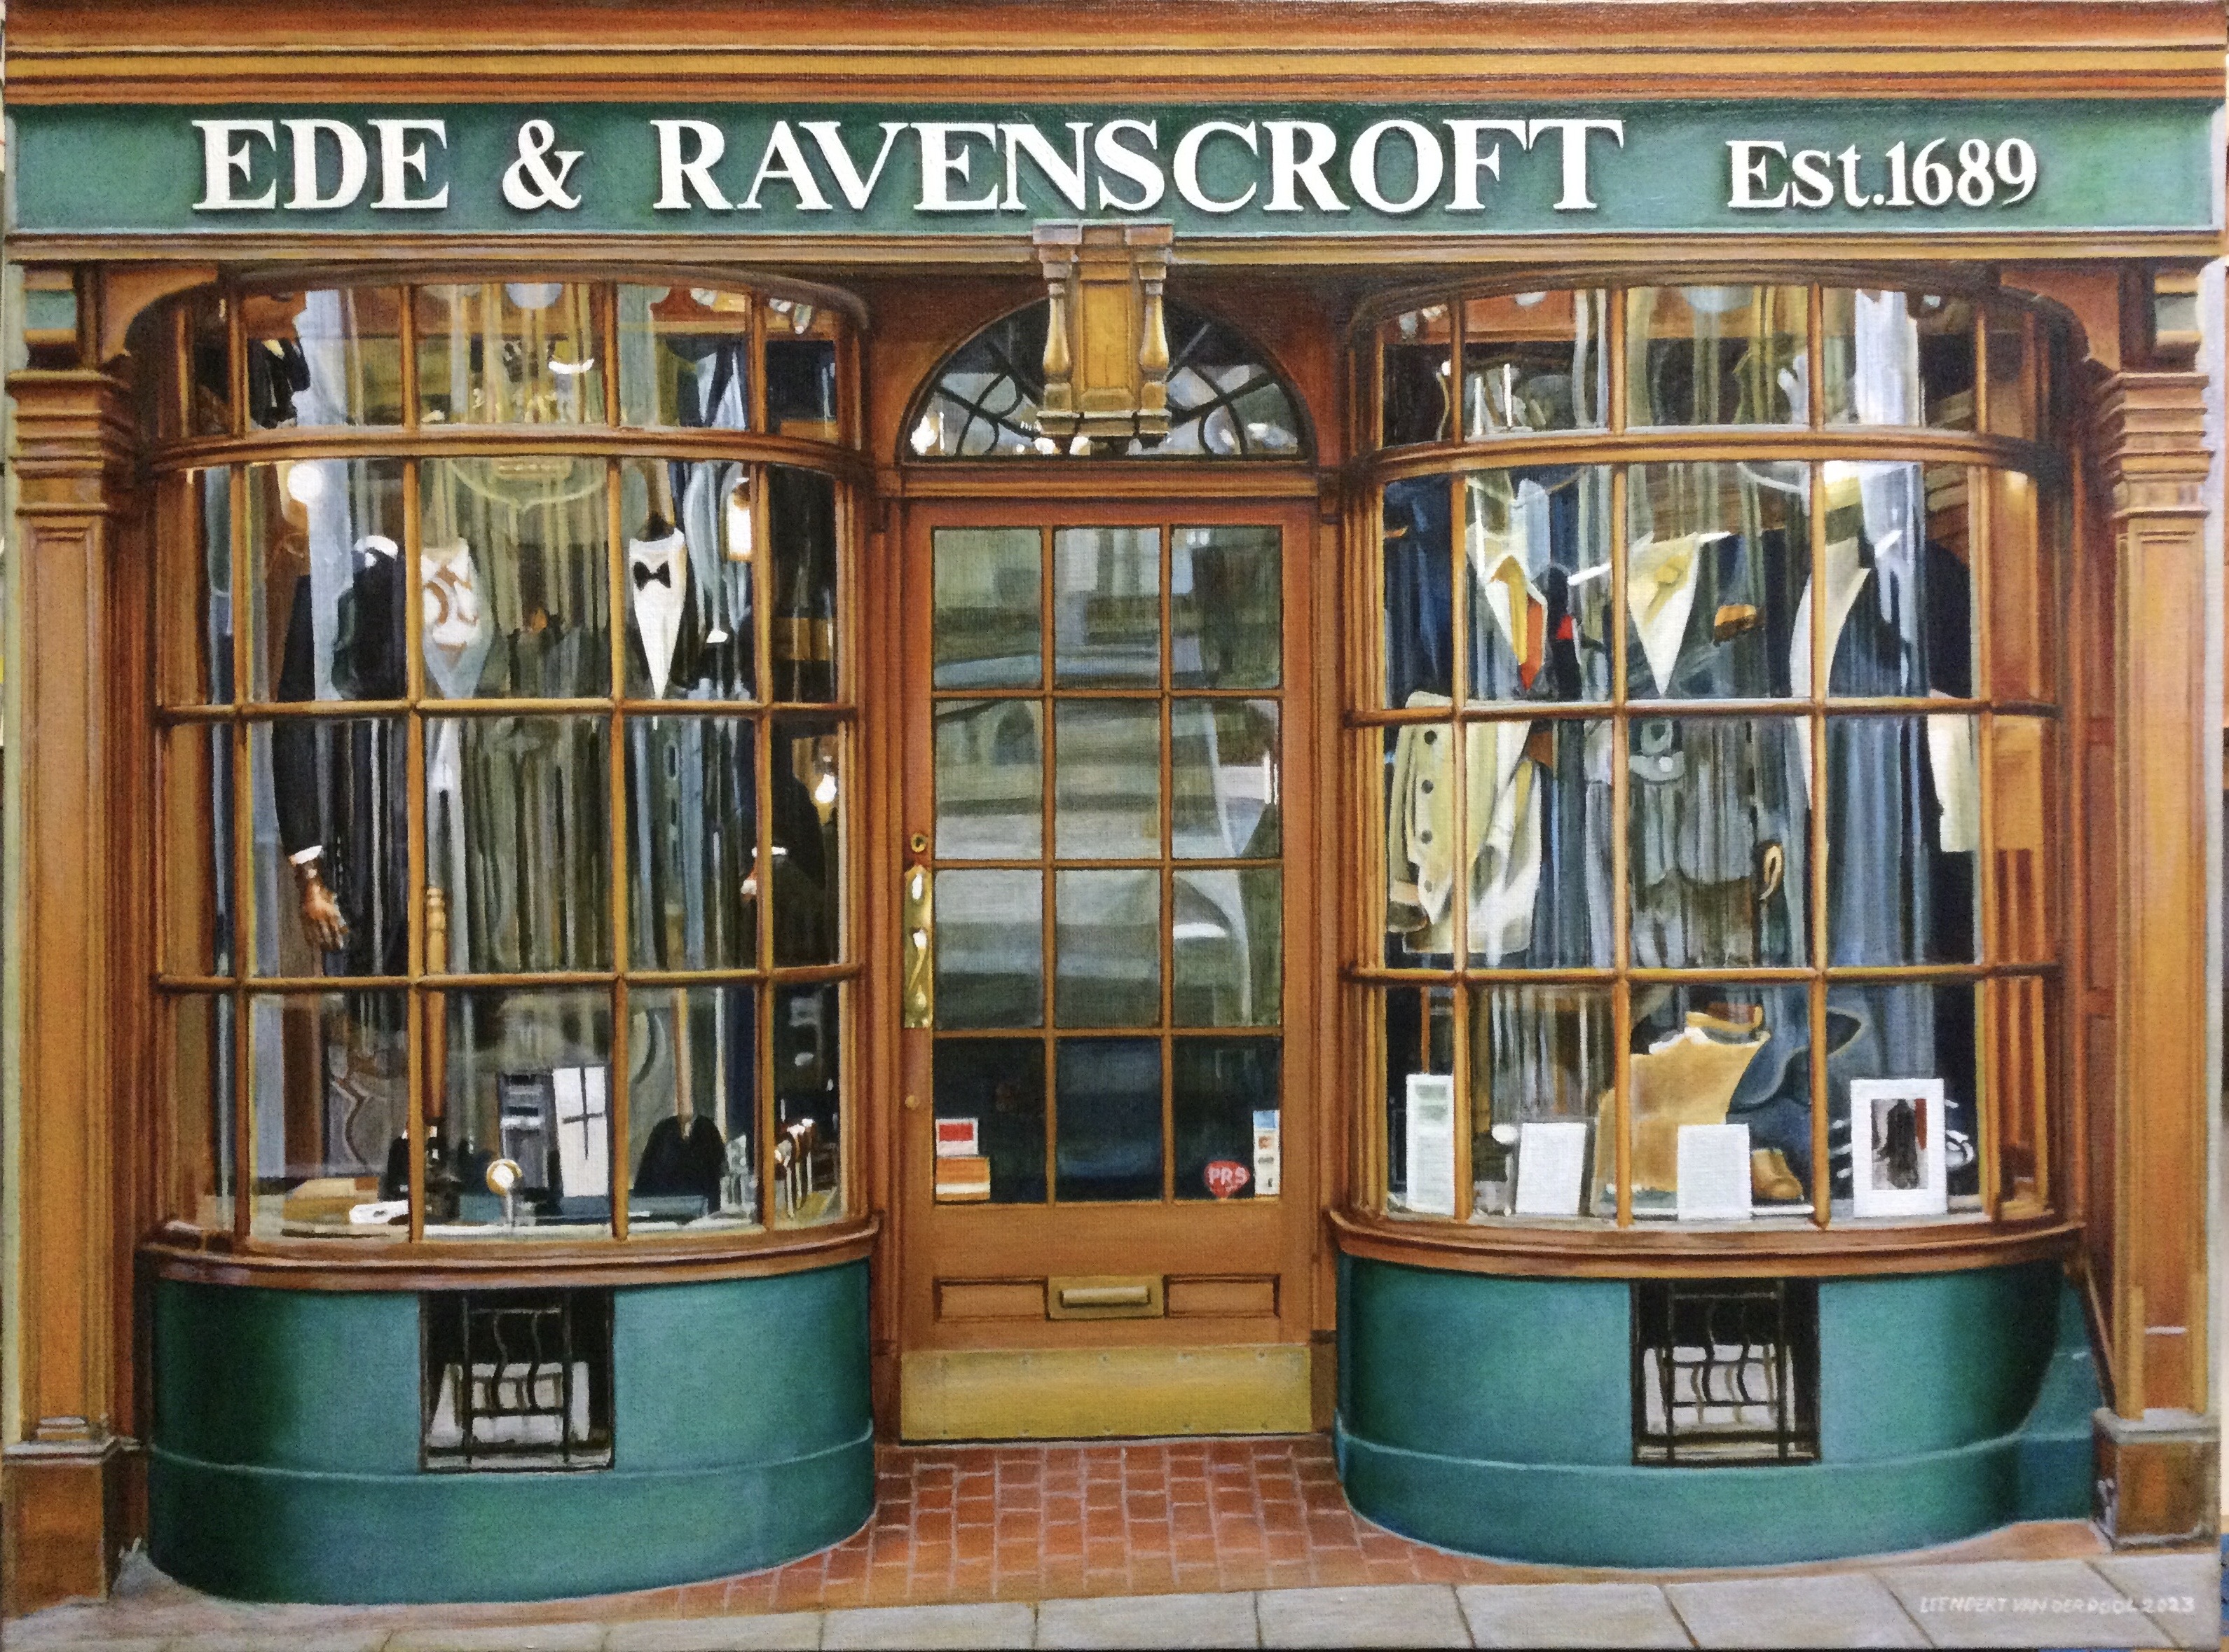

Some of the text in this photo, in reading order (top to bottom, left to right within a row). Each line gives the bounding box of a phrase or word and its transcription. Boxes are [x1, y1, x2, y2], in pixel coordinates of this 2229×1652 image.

[191, 118, 1624, 214] EDE & RAVENSCROFT
[2012, 1597, 2048, 1613] VAN
[2052, 1598, 2084, 1613] DER
[2142, 1596, 2195, 1613] 2023
